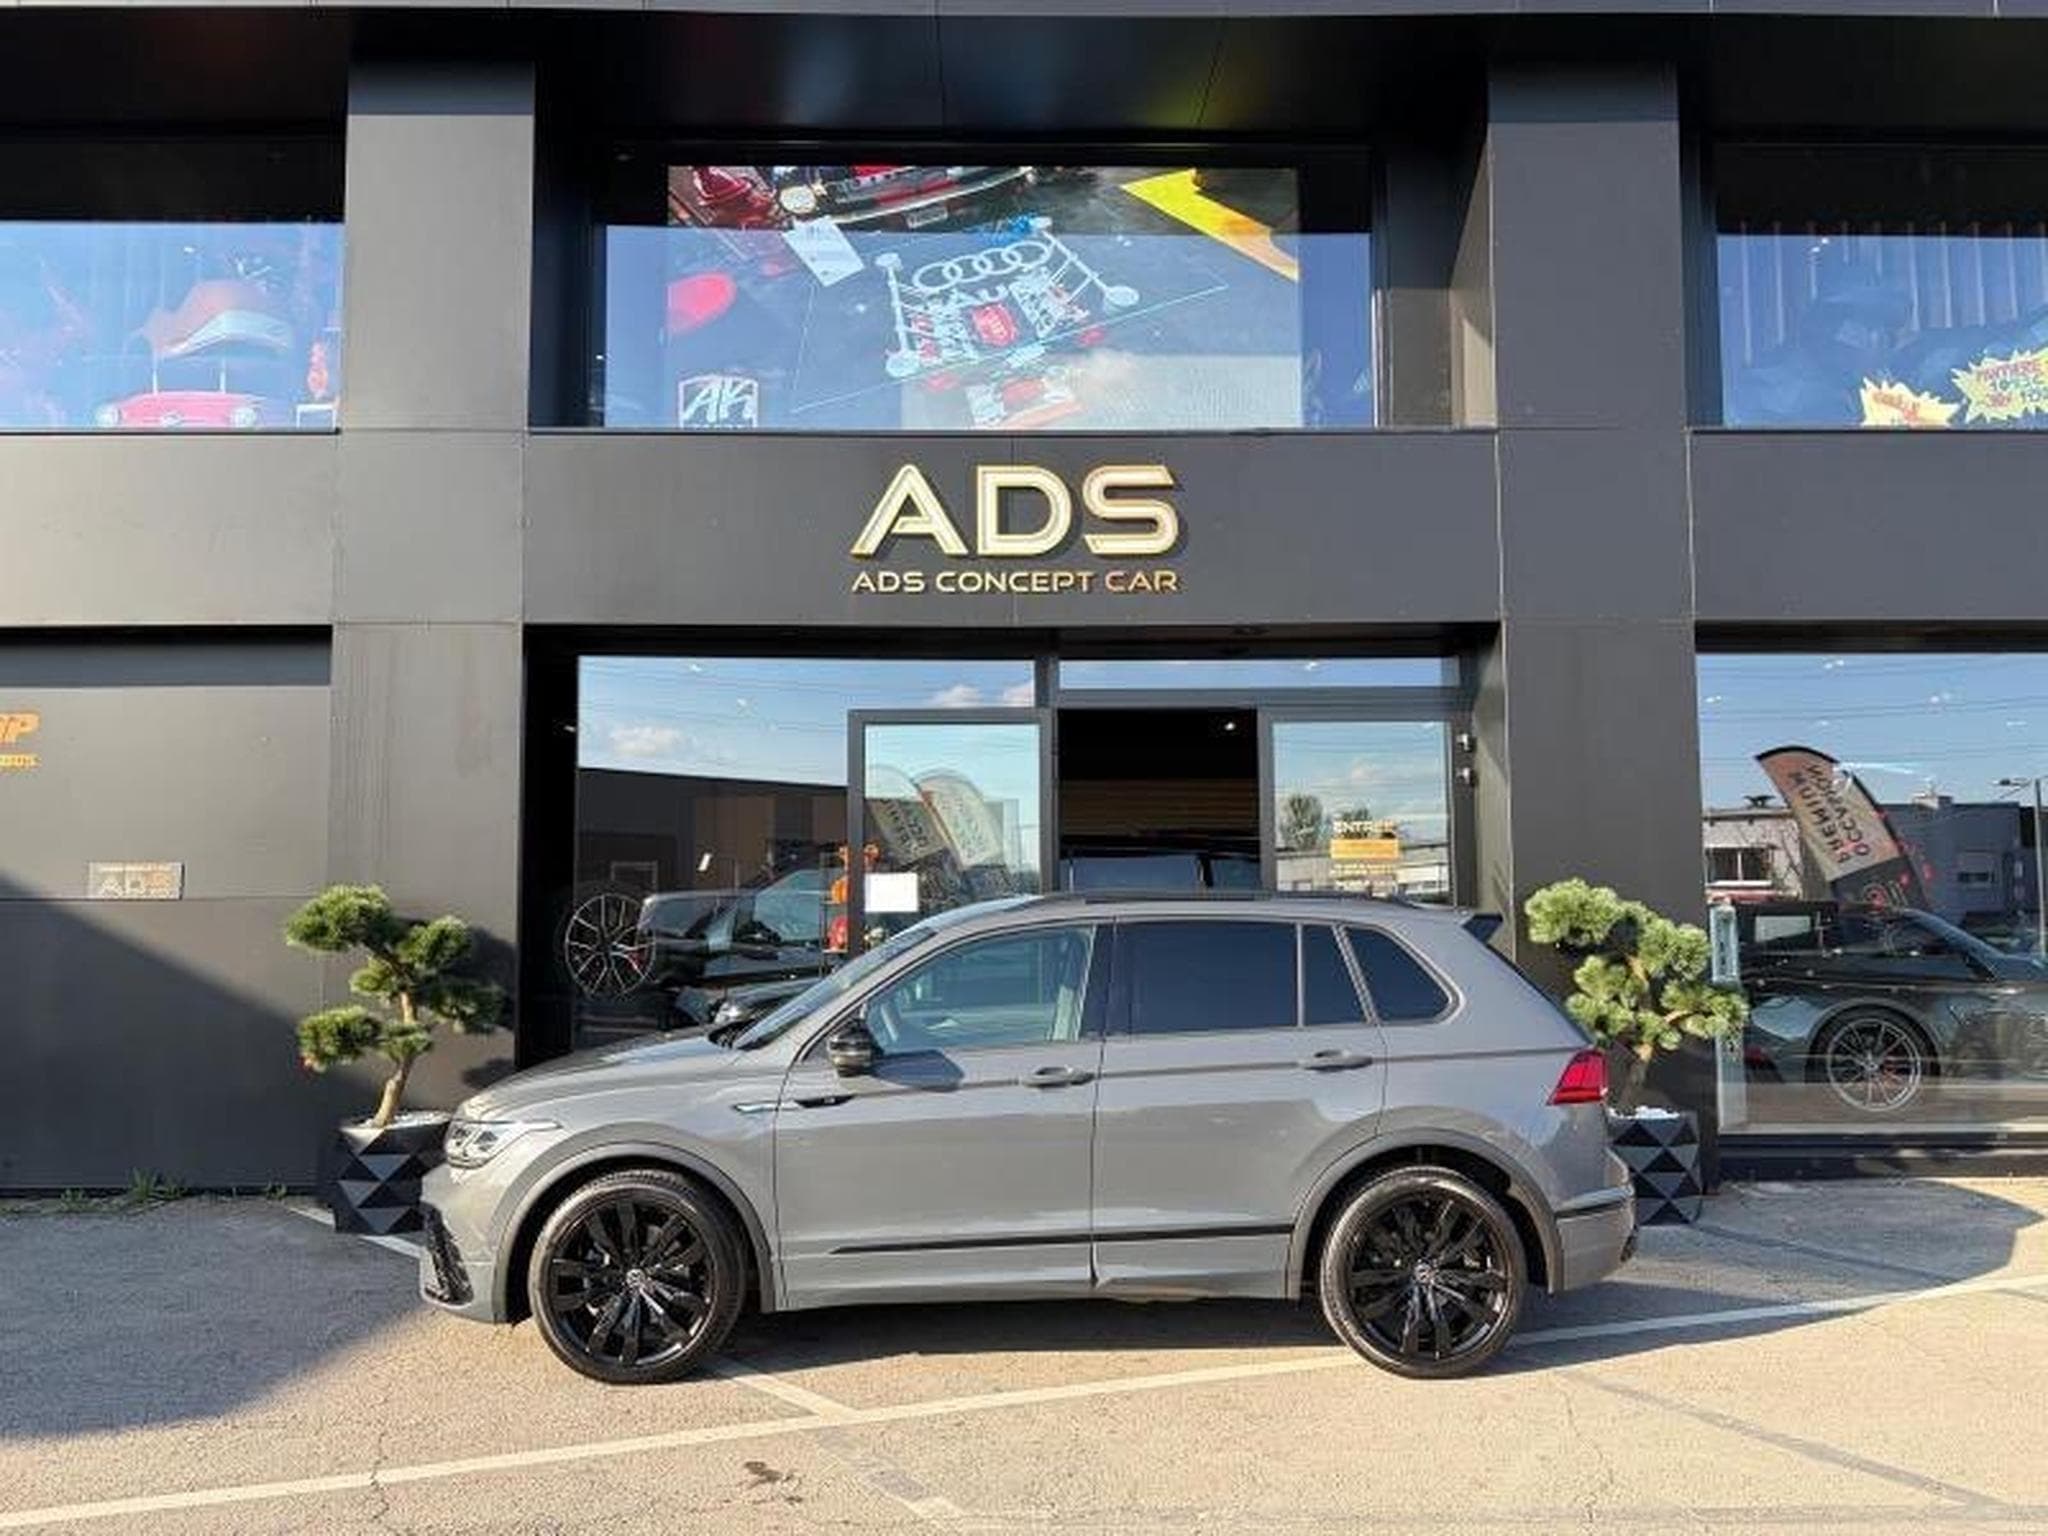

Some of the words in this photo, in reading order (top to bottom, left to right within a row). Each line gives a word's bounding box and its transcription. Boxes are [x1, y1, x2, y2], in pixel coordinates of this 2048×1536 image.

[850, 464, 1180, 556] ADS
[851, 570, 926, 593] ADS
[935, 570, 1095, 593] CONCEPT
[1104, 570, 1179, 593] CAR
